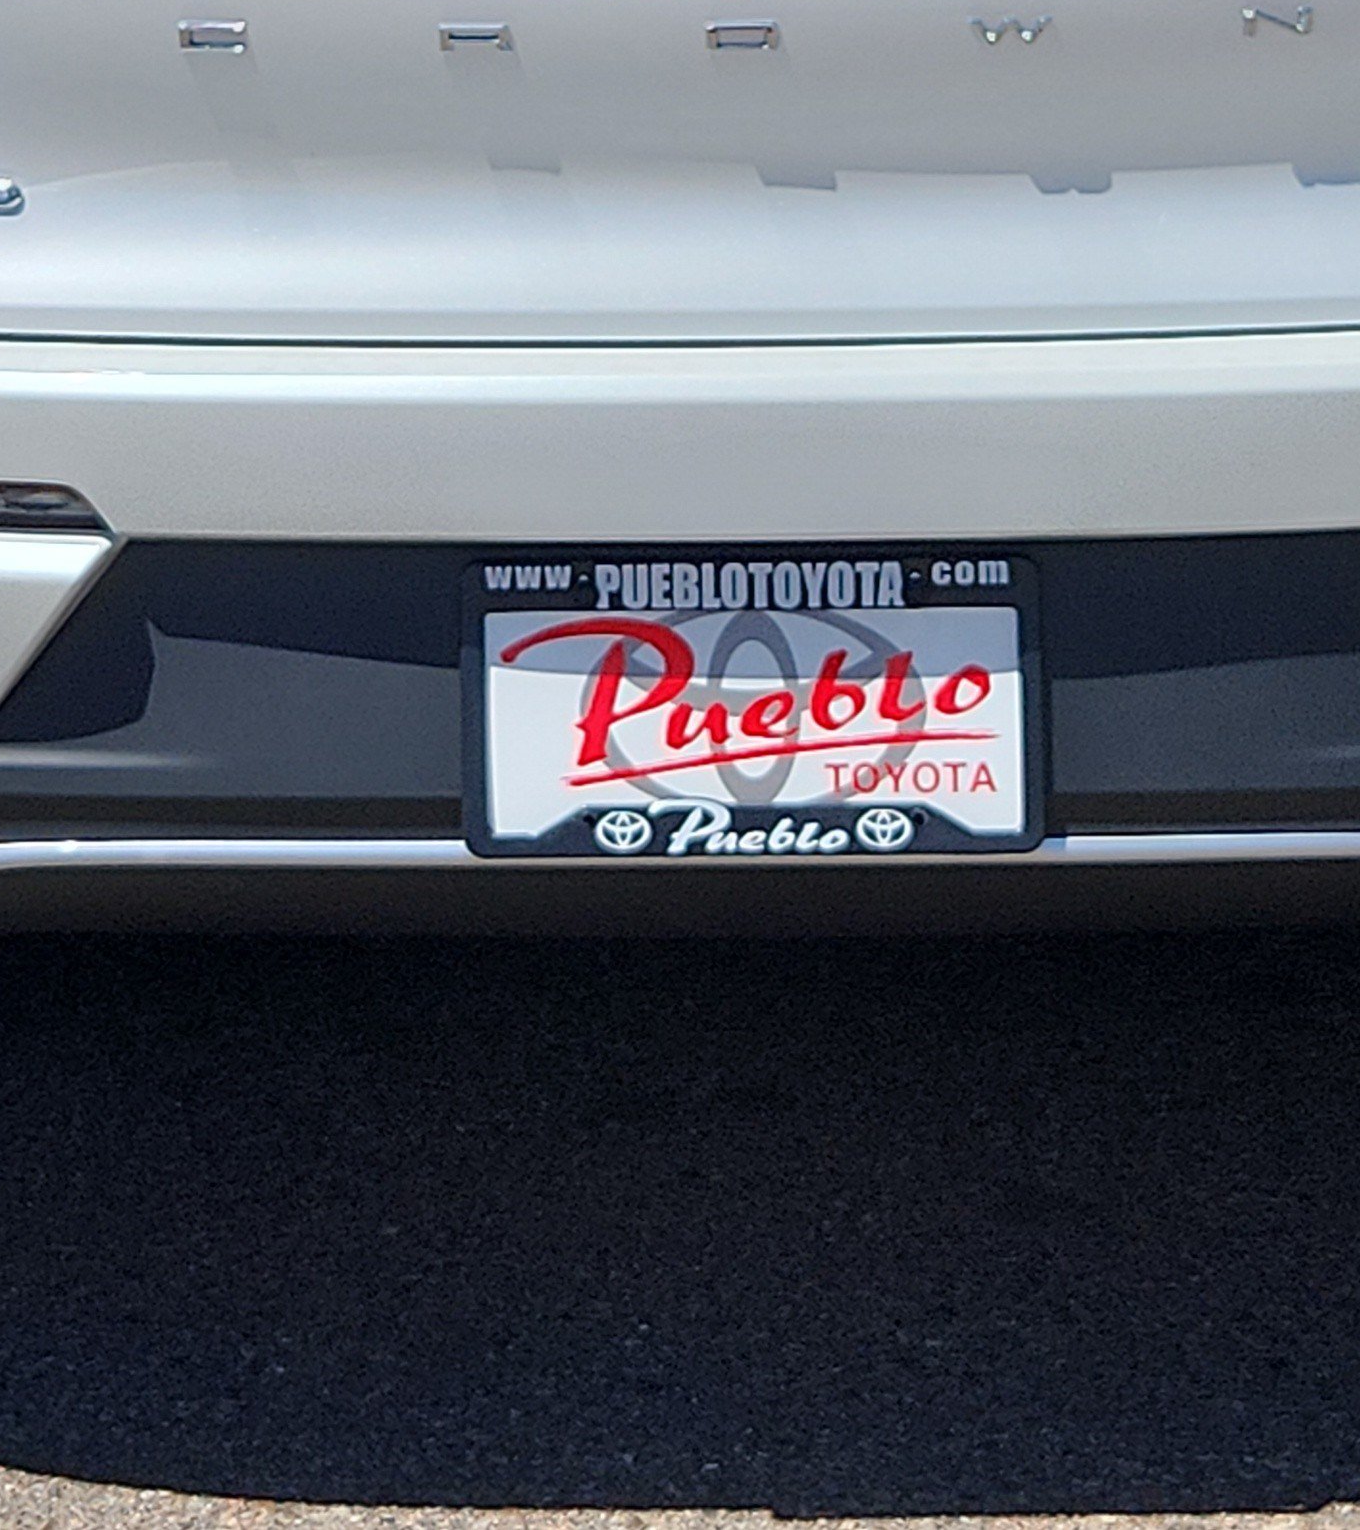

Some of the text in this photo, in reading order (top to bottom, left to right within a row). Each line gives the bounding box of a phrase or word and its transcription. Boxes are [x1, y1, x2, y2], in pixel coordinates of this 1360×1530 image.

[595, 560, 906, 610] PUEBLOTOYOTA
[500, 616, 992, 766] Pueblo
[826, 762, 997, 793] TOYOTA
[647, 799, 851, 854] Pueblo
